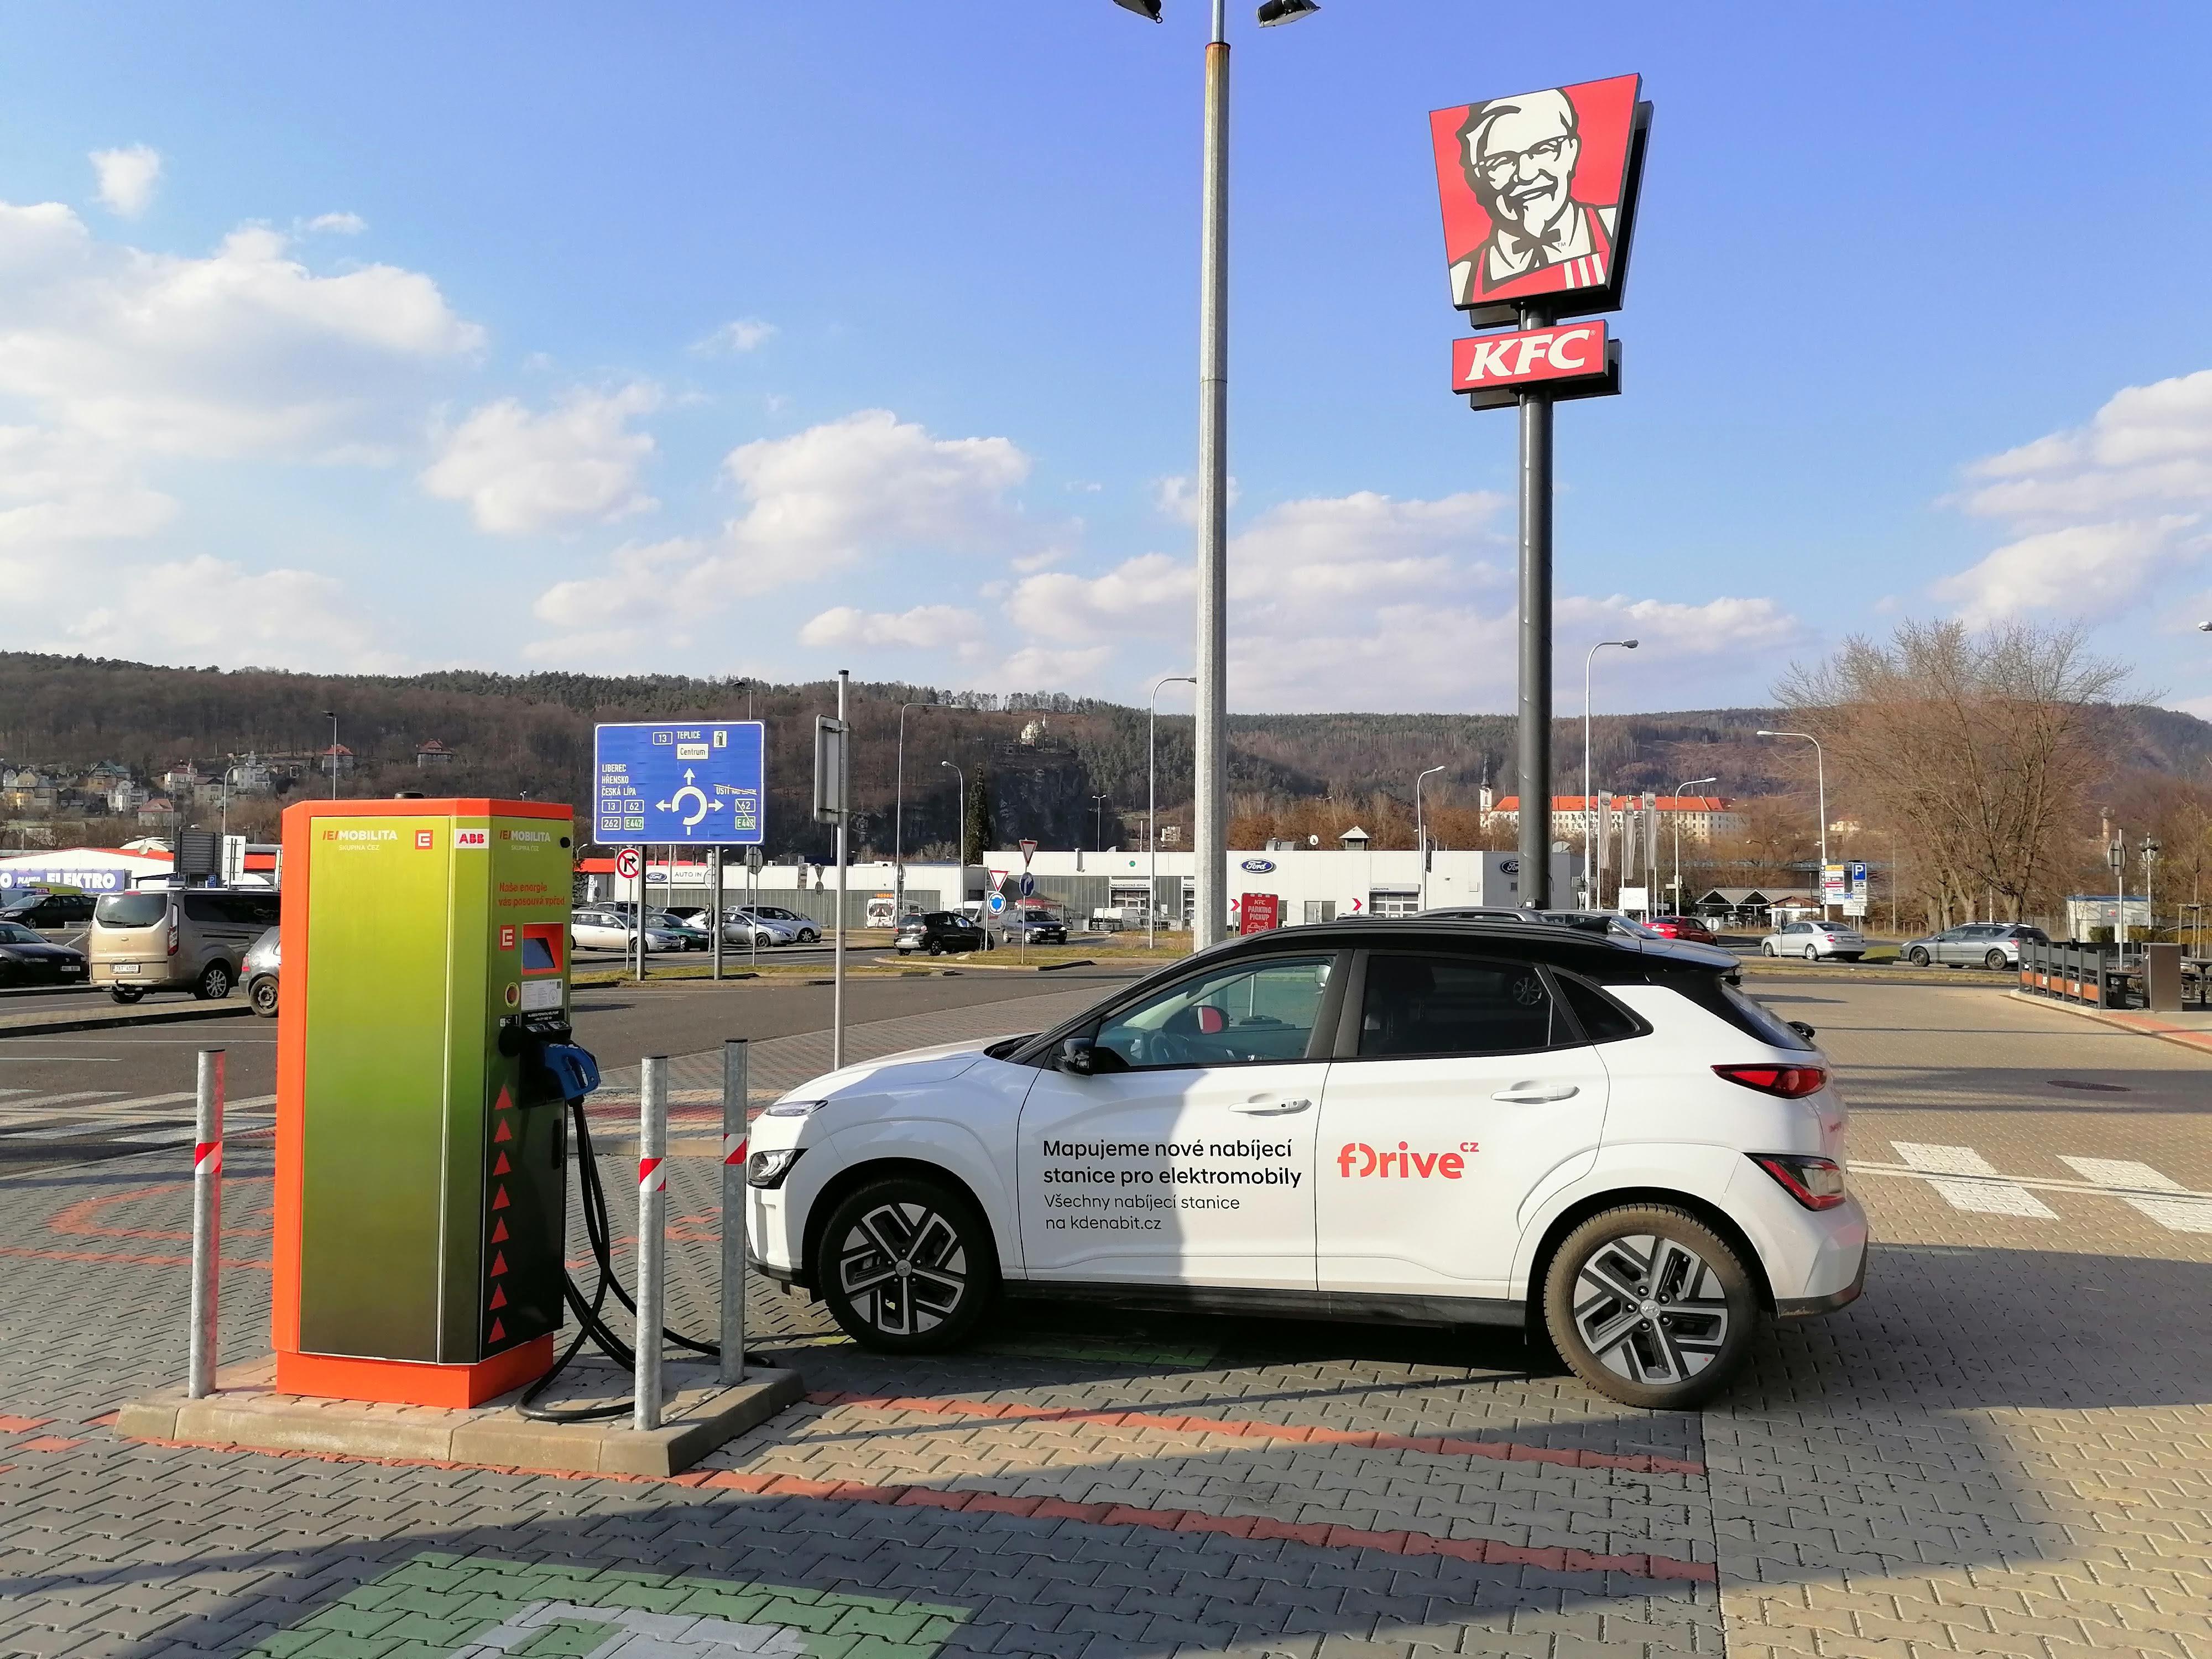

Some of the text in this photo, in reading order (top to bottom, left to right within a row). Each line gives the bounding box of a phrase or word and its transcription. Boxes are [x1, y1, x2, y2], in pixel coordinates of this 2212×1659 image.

[1465, 330, 1590, 380] KFC
[677, 731, 701, 739] TEPLICE
[680, 748, 706, 756] Centrum
[602, 764, 627, 773] LIBEREC
[602, 774, 629, 784] HŘENSKO
[602, 785, 637, 796] ČESKÁ LÍPA
[741, 801, 750, 810] 62
[603, 820, 618, 828] 262
[625, 820, 642, 828] E442
[459, 833, 484, 844] ABB
[1855, 865, 1864, 876] P
[499, 883, 547, 893] Naše energie
[498, 897, 512, 906] vás
[1249, 913, 1270, 921] PICKUP
[1043, 1139, 1292, 1160] Mapujeme nové nabíjecí
[1043, 1167, 1302, 1188] stanice pro elektromobily
[1044, 1193, 1240, 1212] Všechny nabíjecí stanice
[1046, 1215, 1162, 1230] na kdenabit.cz
